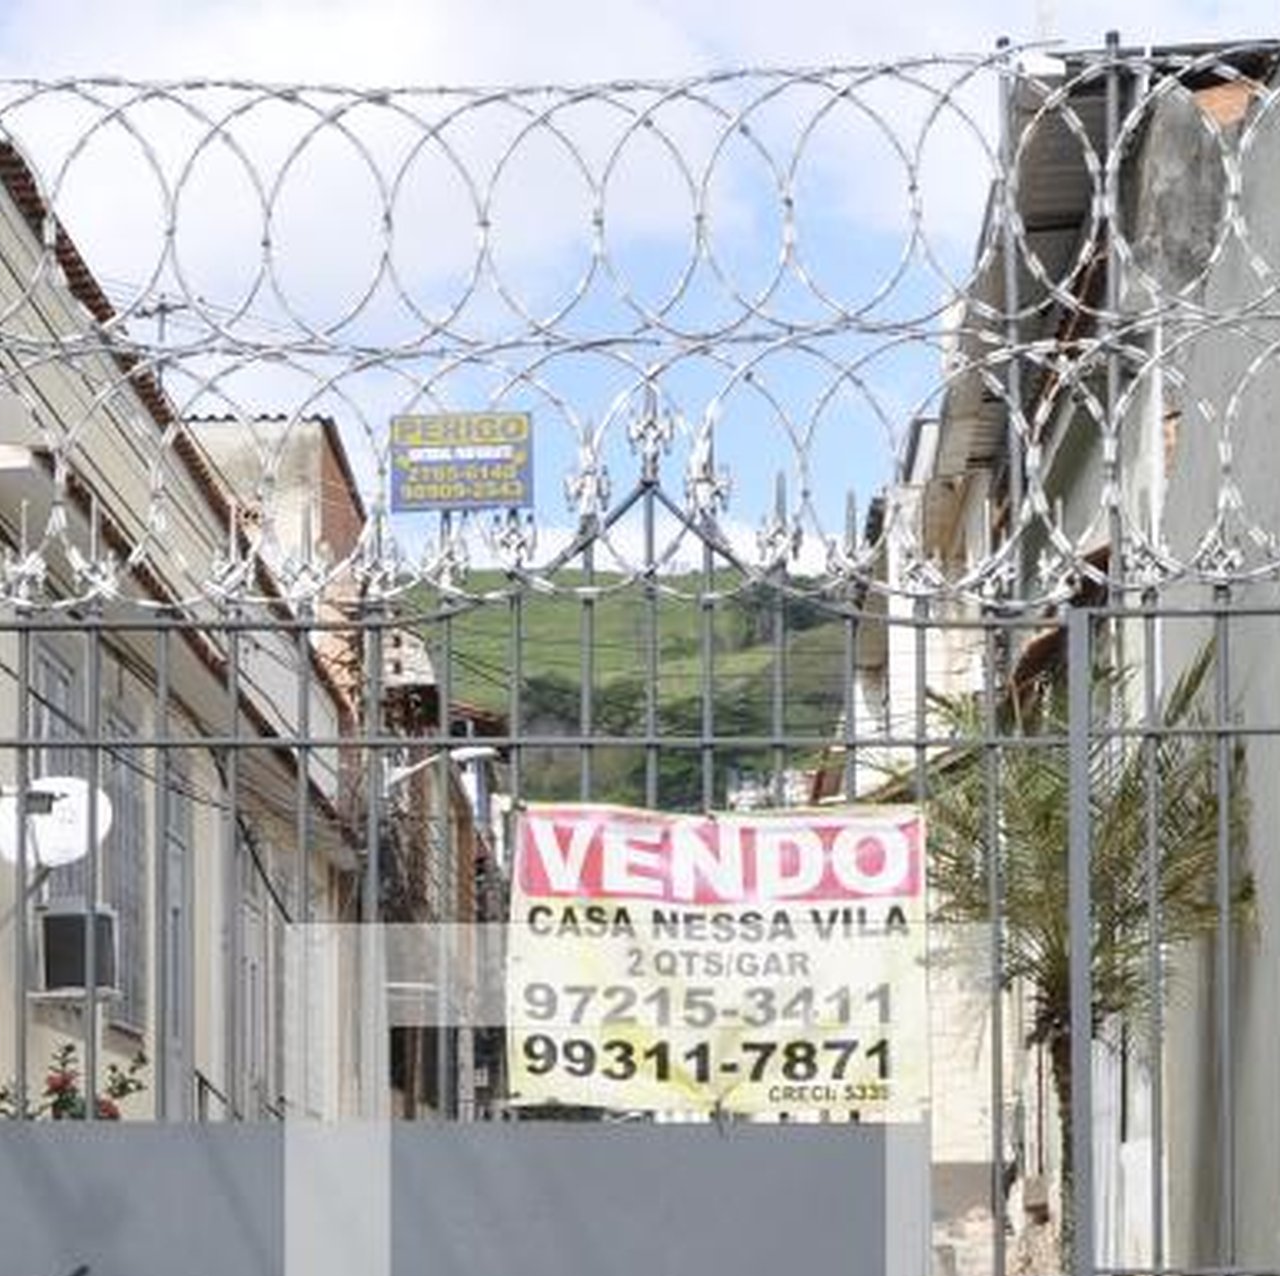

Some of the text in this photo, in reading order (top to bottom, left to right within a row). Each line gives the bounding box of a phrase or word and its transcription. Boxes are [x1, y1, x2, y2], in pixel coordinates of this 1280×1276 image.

[528, 815, 910, 900] VENDO
[527, 905, 910, 942] CASA NESSA VILA
[627, 949, 811, 978] 2 QTS/GAR
[523, 982, 894, 1027] 97215-3411
[523, 1034, 891, 1084] 99311-7871
